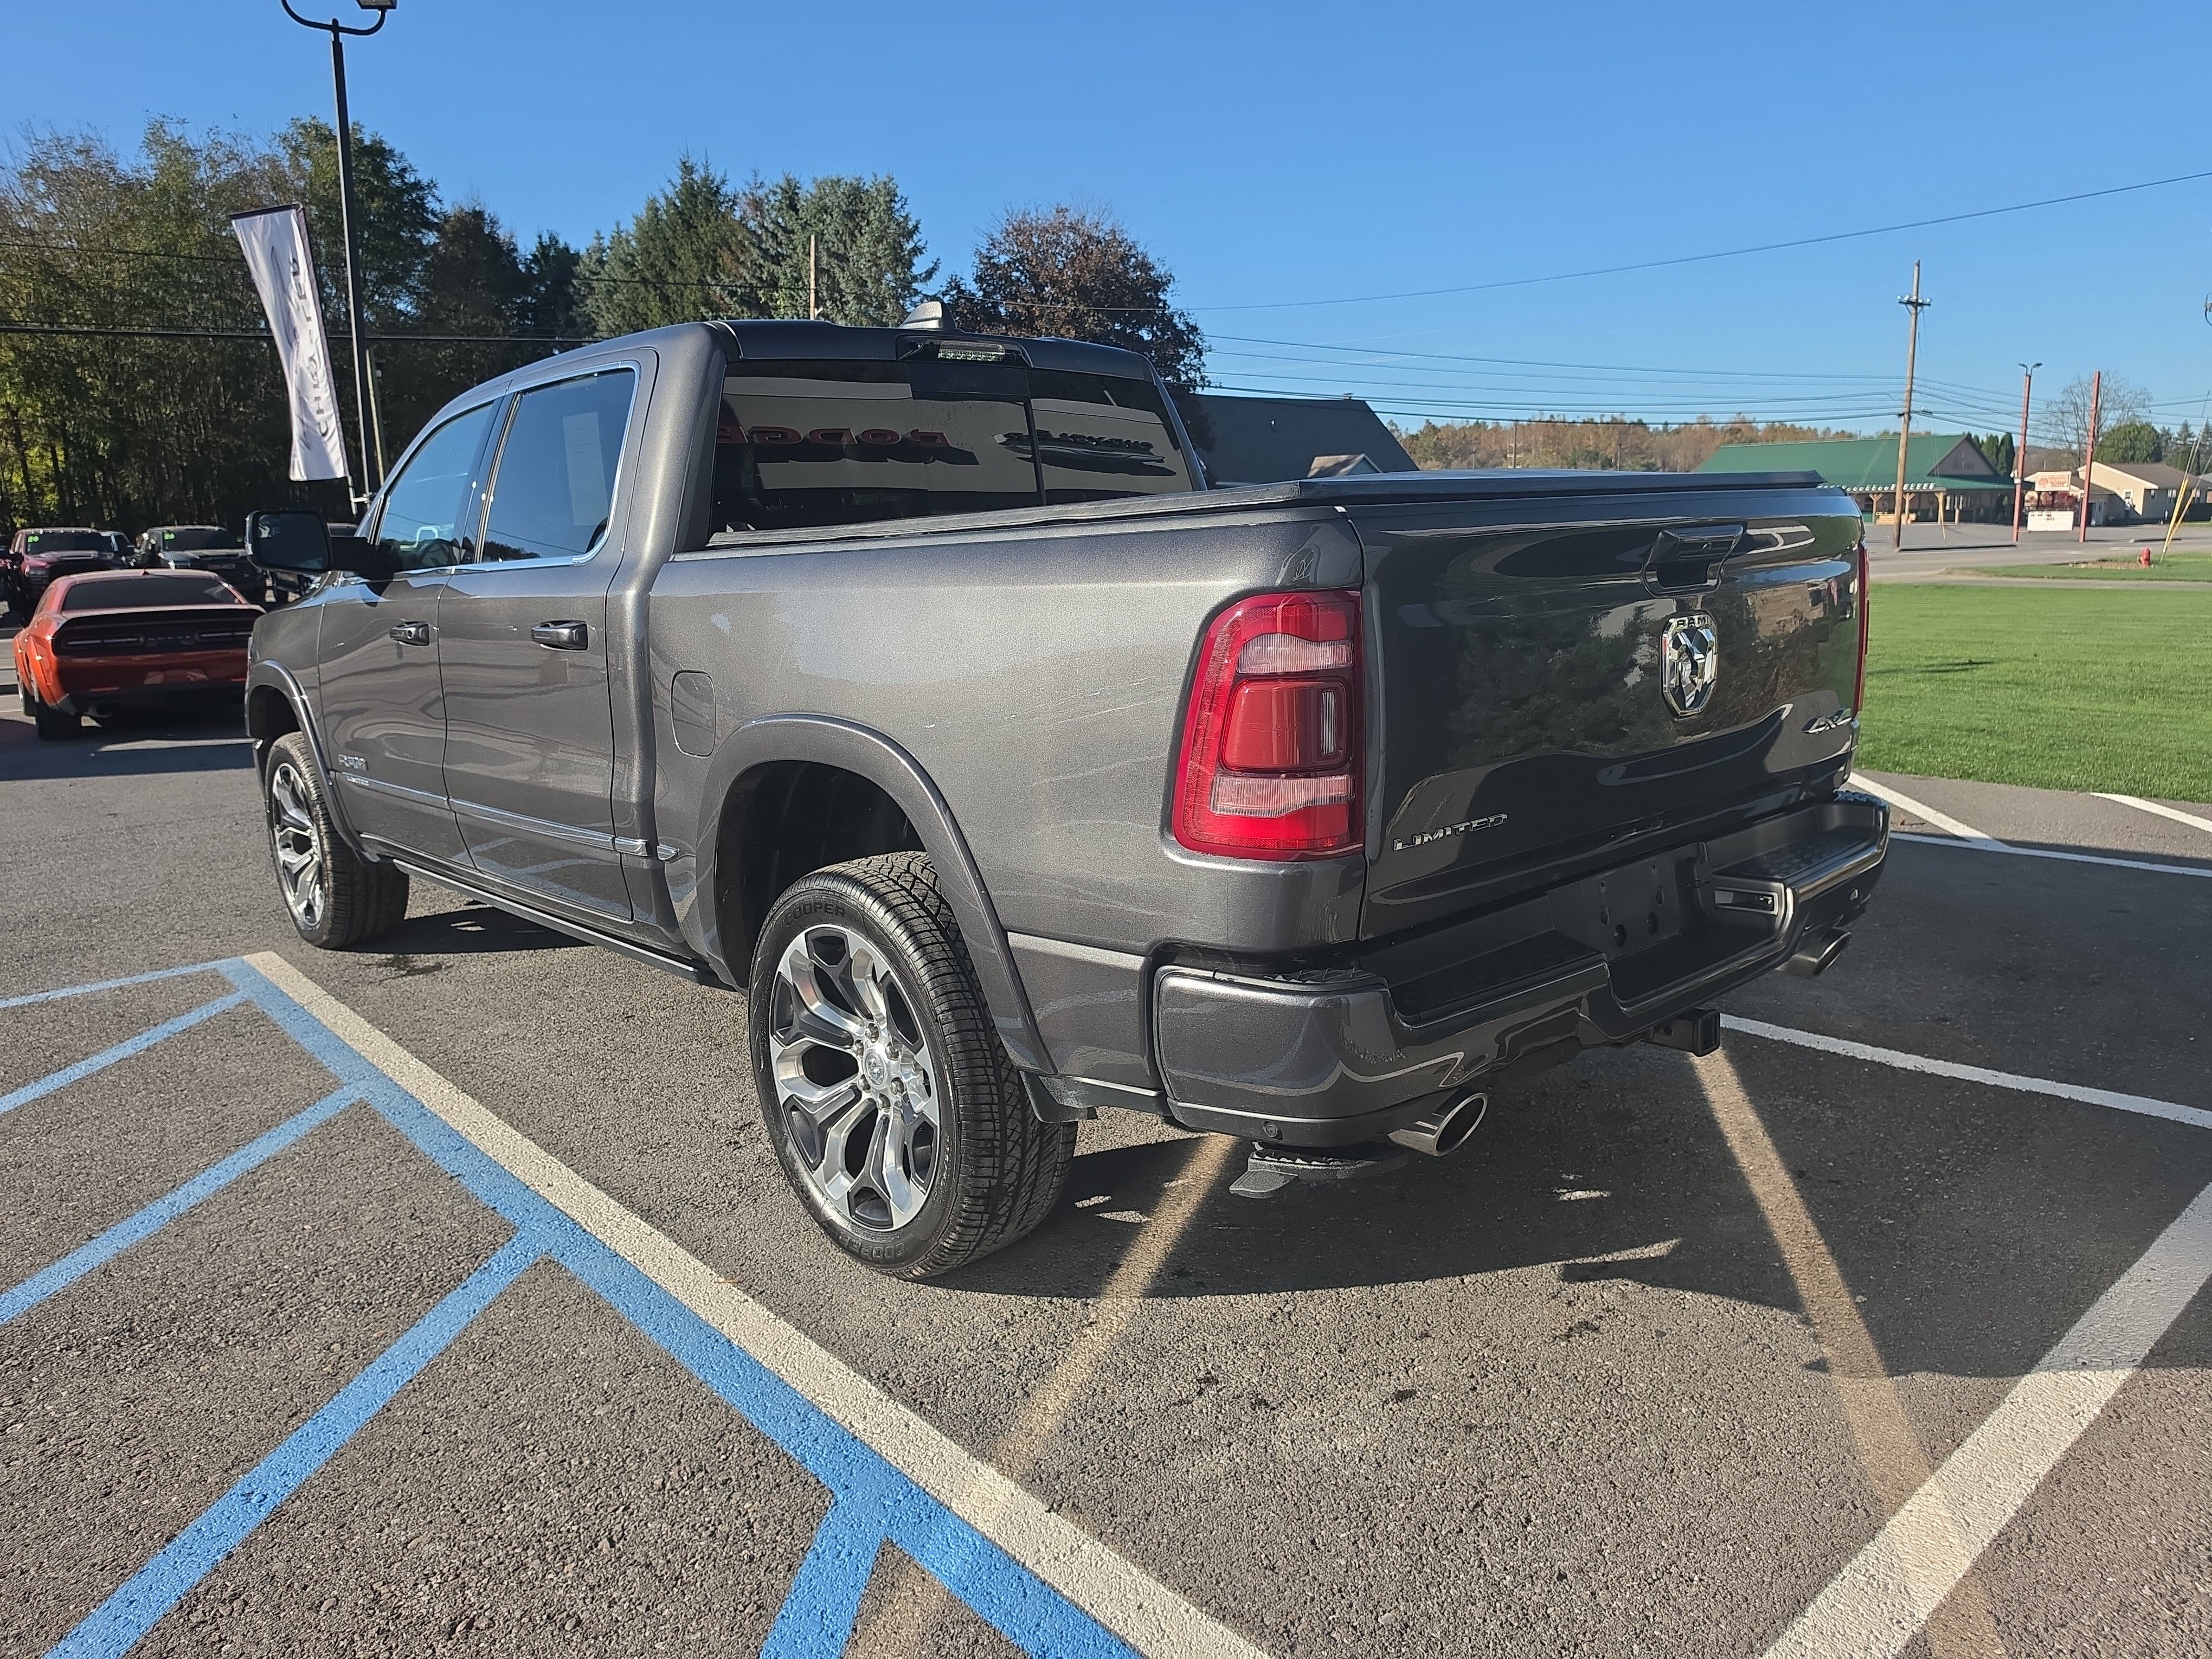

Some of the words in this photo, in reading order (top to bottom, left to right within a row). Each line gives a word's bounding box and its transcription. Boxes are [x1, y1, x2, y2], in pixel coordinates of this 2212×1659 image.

[1677, 615, 1708, 628] RAM
[1245, 722, 1304, 734] RAM
[1393, 813, 1509, 852] LIMITED
[786, 902, 846, 925] COOPER
[839, 1231, 904, 1261] COOPER
